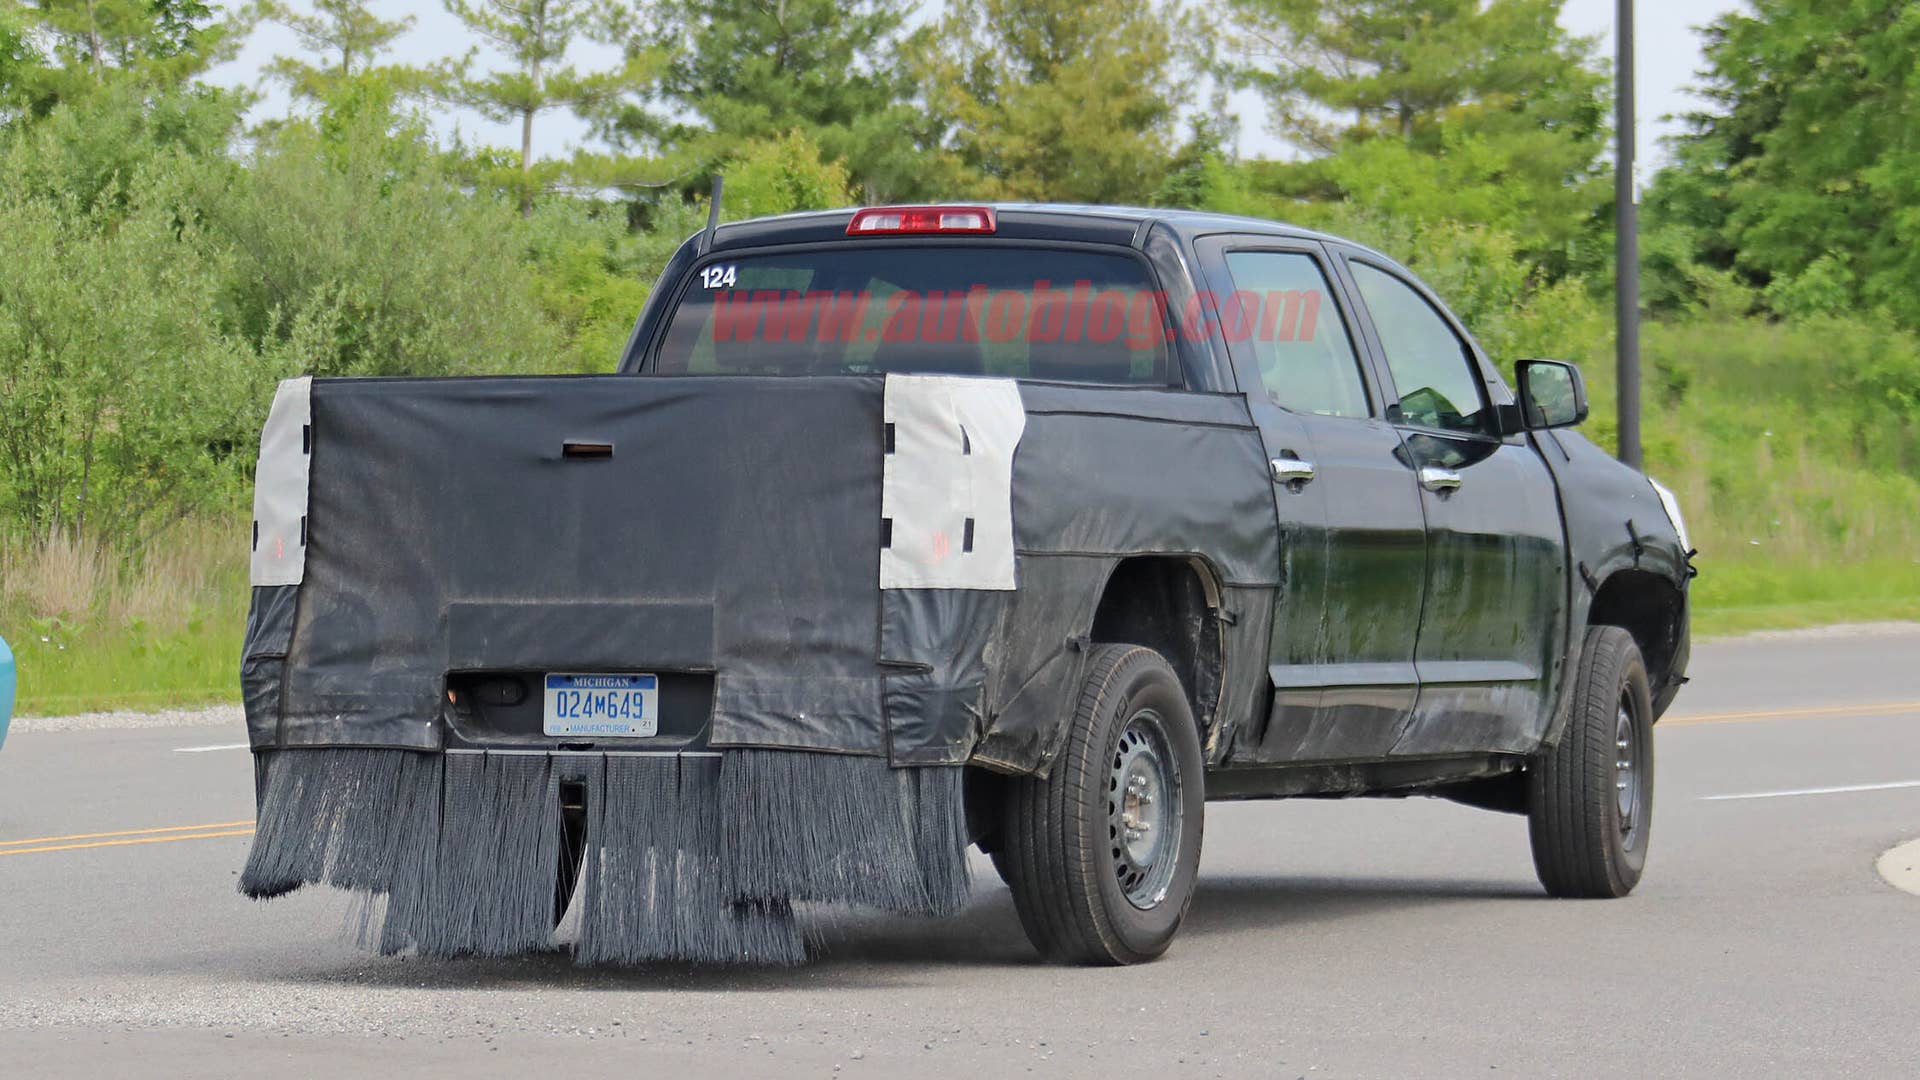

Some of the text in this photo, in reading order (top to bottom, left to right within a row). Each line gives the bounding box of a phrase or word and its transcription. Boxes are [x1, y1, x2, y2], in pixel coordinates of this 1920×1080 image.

[701, 265, 736, 289] 124
[574, 677, 629, 687] MICHIGAN
[557, 691, 643, 719] 024M649
[570, 724, 630, 732] MANUFACTURER
